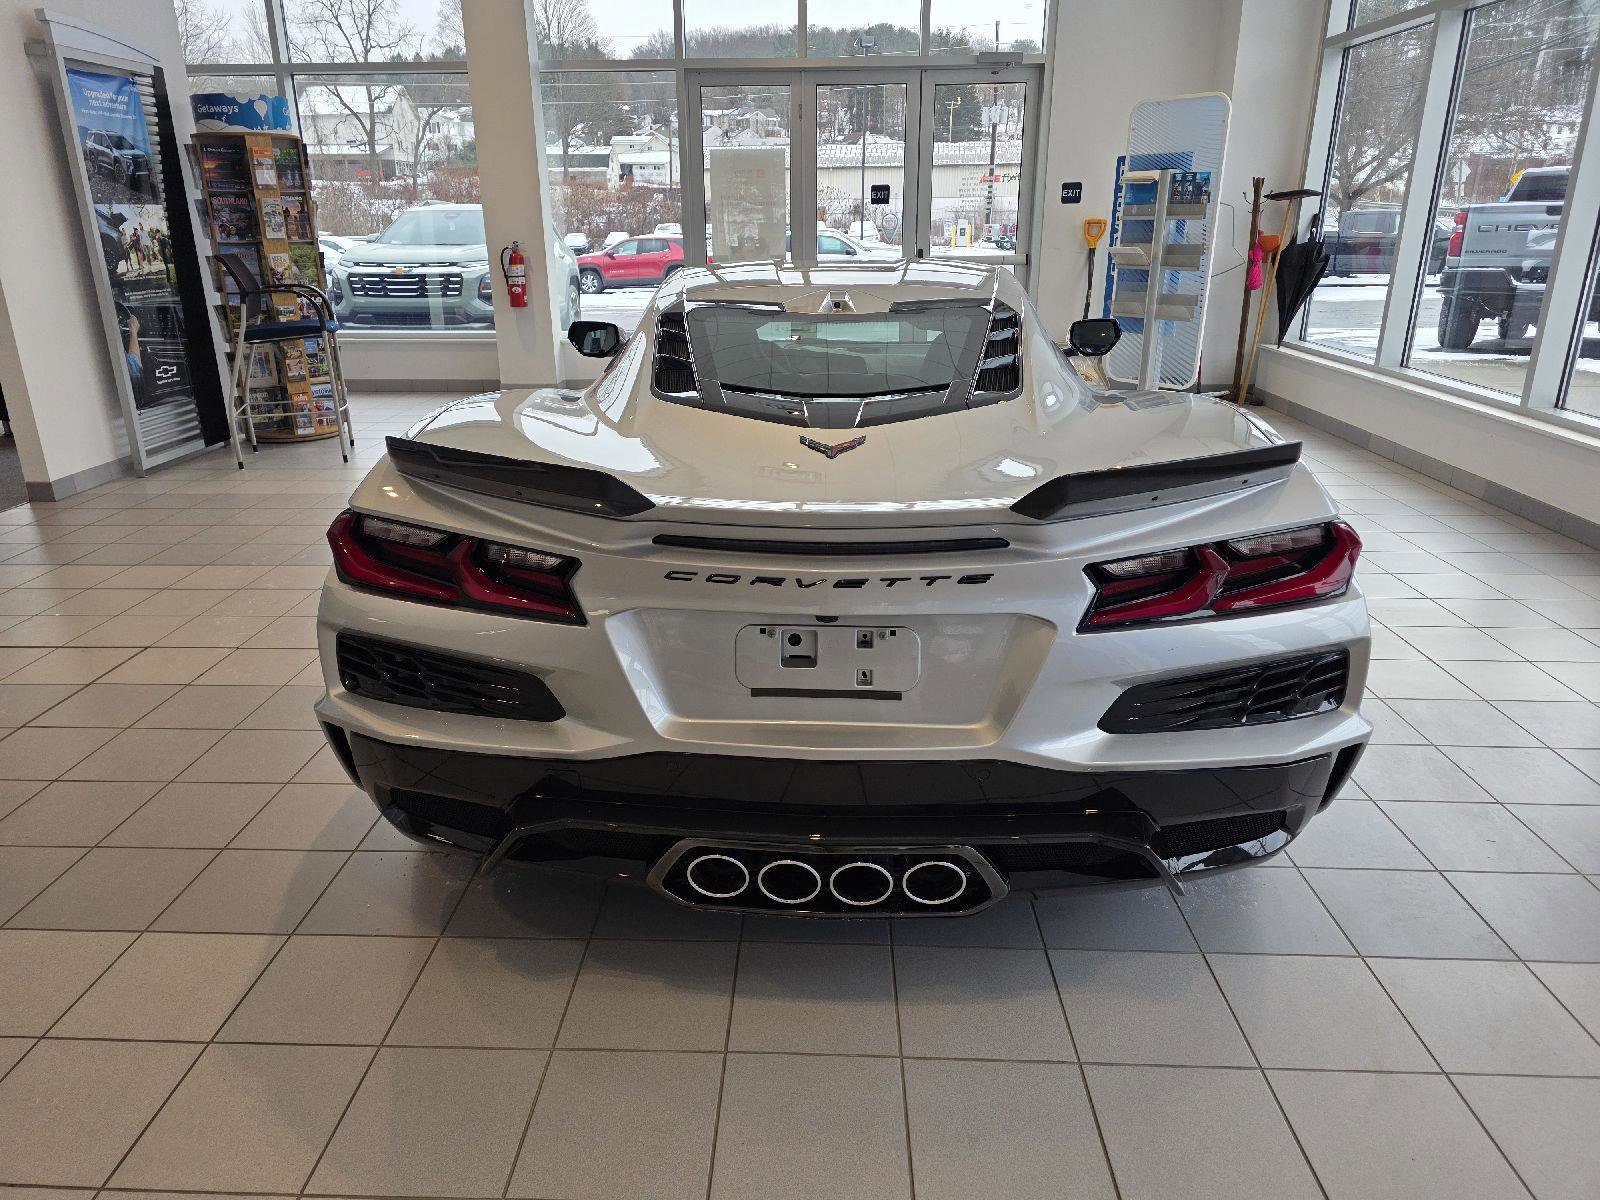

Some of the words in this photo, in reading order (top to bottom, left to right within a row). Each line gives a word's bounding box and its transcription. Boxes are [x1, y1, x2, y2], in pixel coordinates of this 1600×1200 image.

[197, 104, 239, 114] Getaways
[1062, 189, 1080, 197] EXIT
[664, 570, 994, 588] CORVETTE
